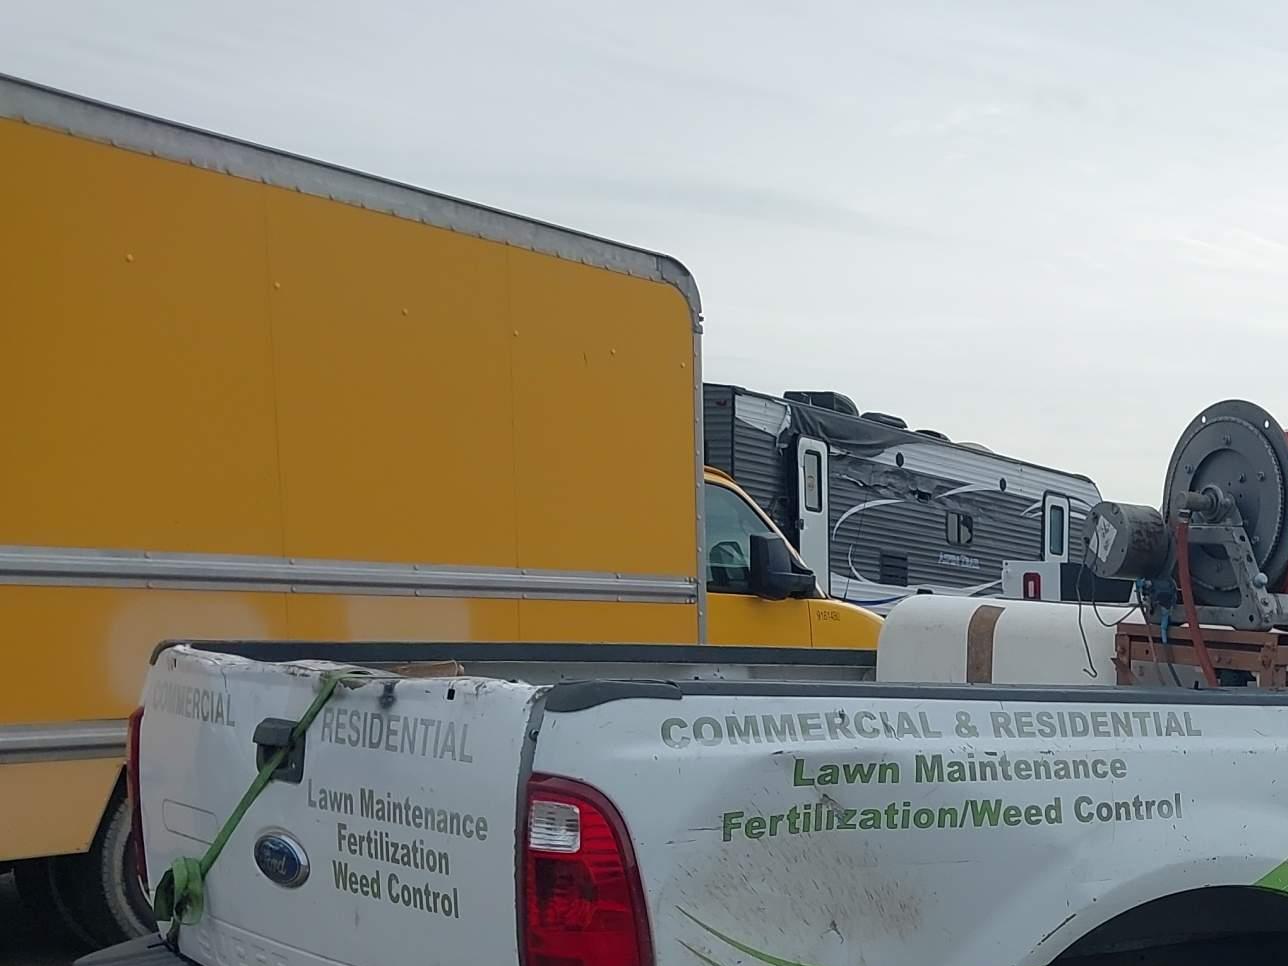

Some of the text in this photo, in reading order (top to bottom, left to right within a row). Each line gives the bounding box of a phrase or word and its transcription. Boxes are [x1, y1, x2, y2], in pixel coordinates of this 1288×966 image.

[322, 707, 473, 763] RESIDENTIAL
[660, 710, 1202, 749] COMMERCIAL & RESIDENTIAL
[792, 752, 1128, 787] Lawn Maintenance
[307, 779, 488, 841] Lawn Maintenance
[721, 793, 1183, 842] Fertilization/Weed Control
[337, 823, 450, 876] Fertilization
[332, 860, 460, 919] Weed Control
